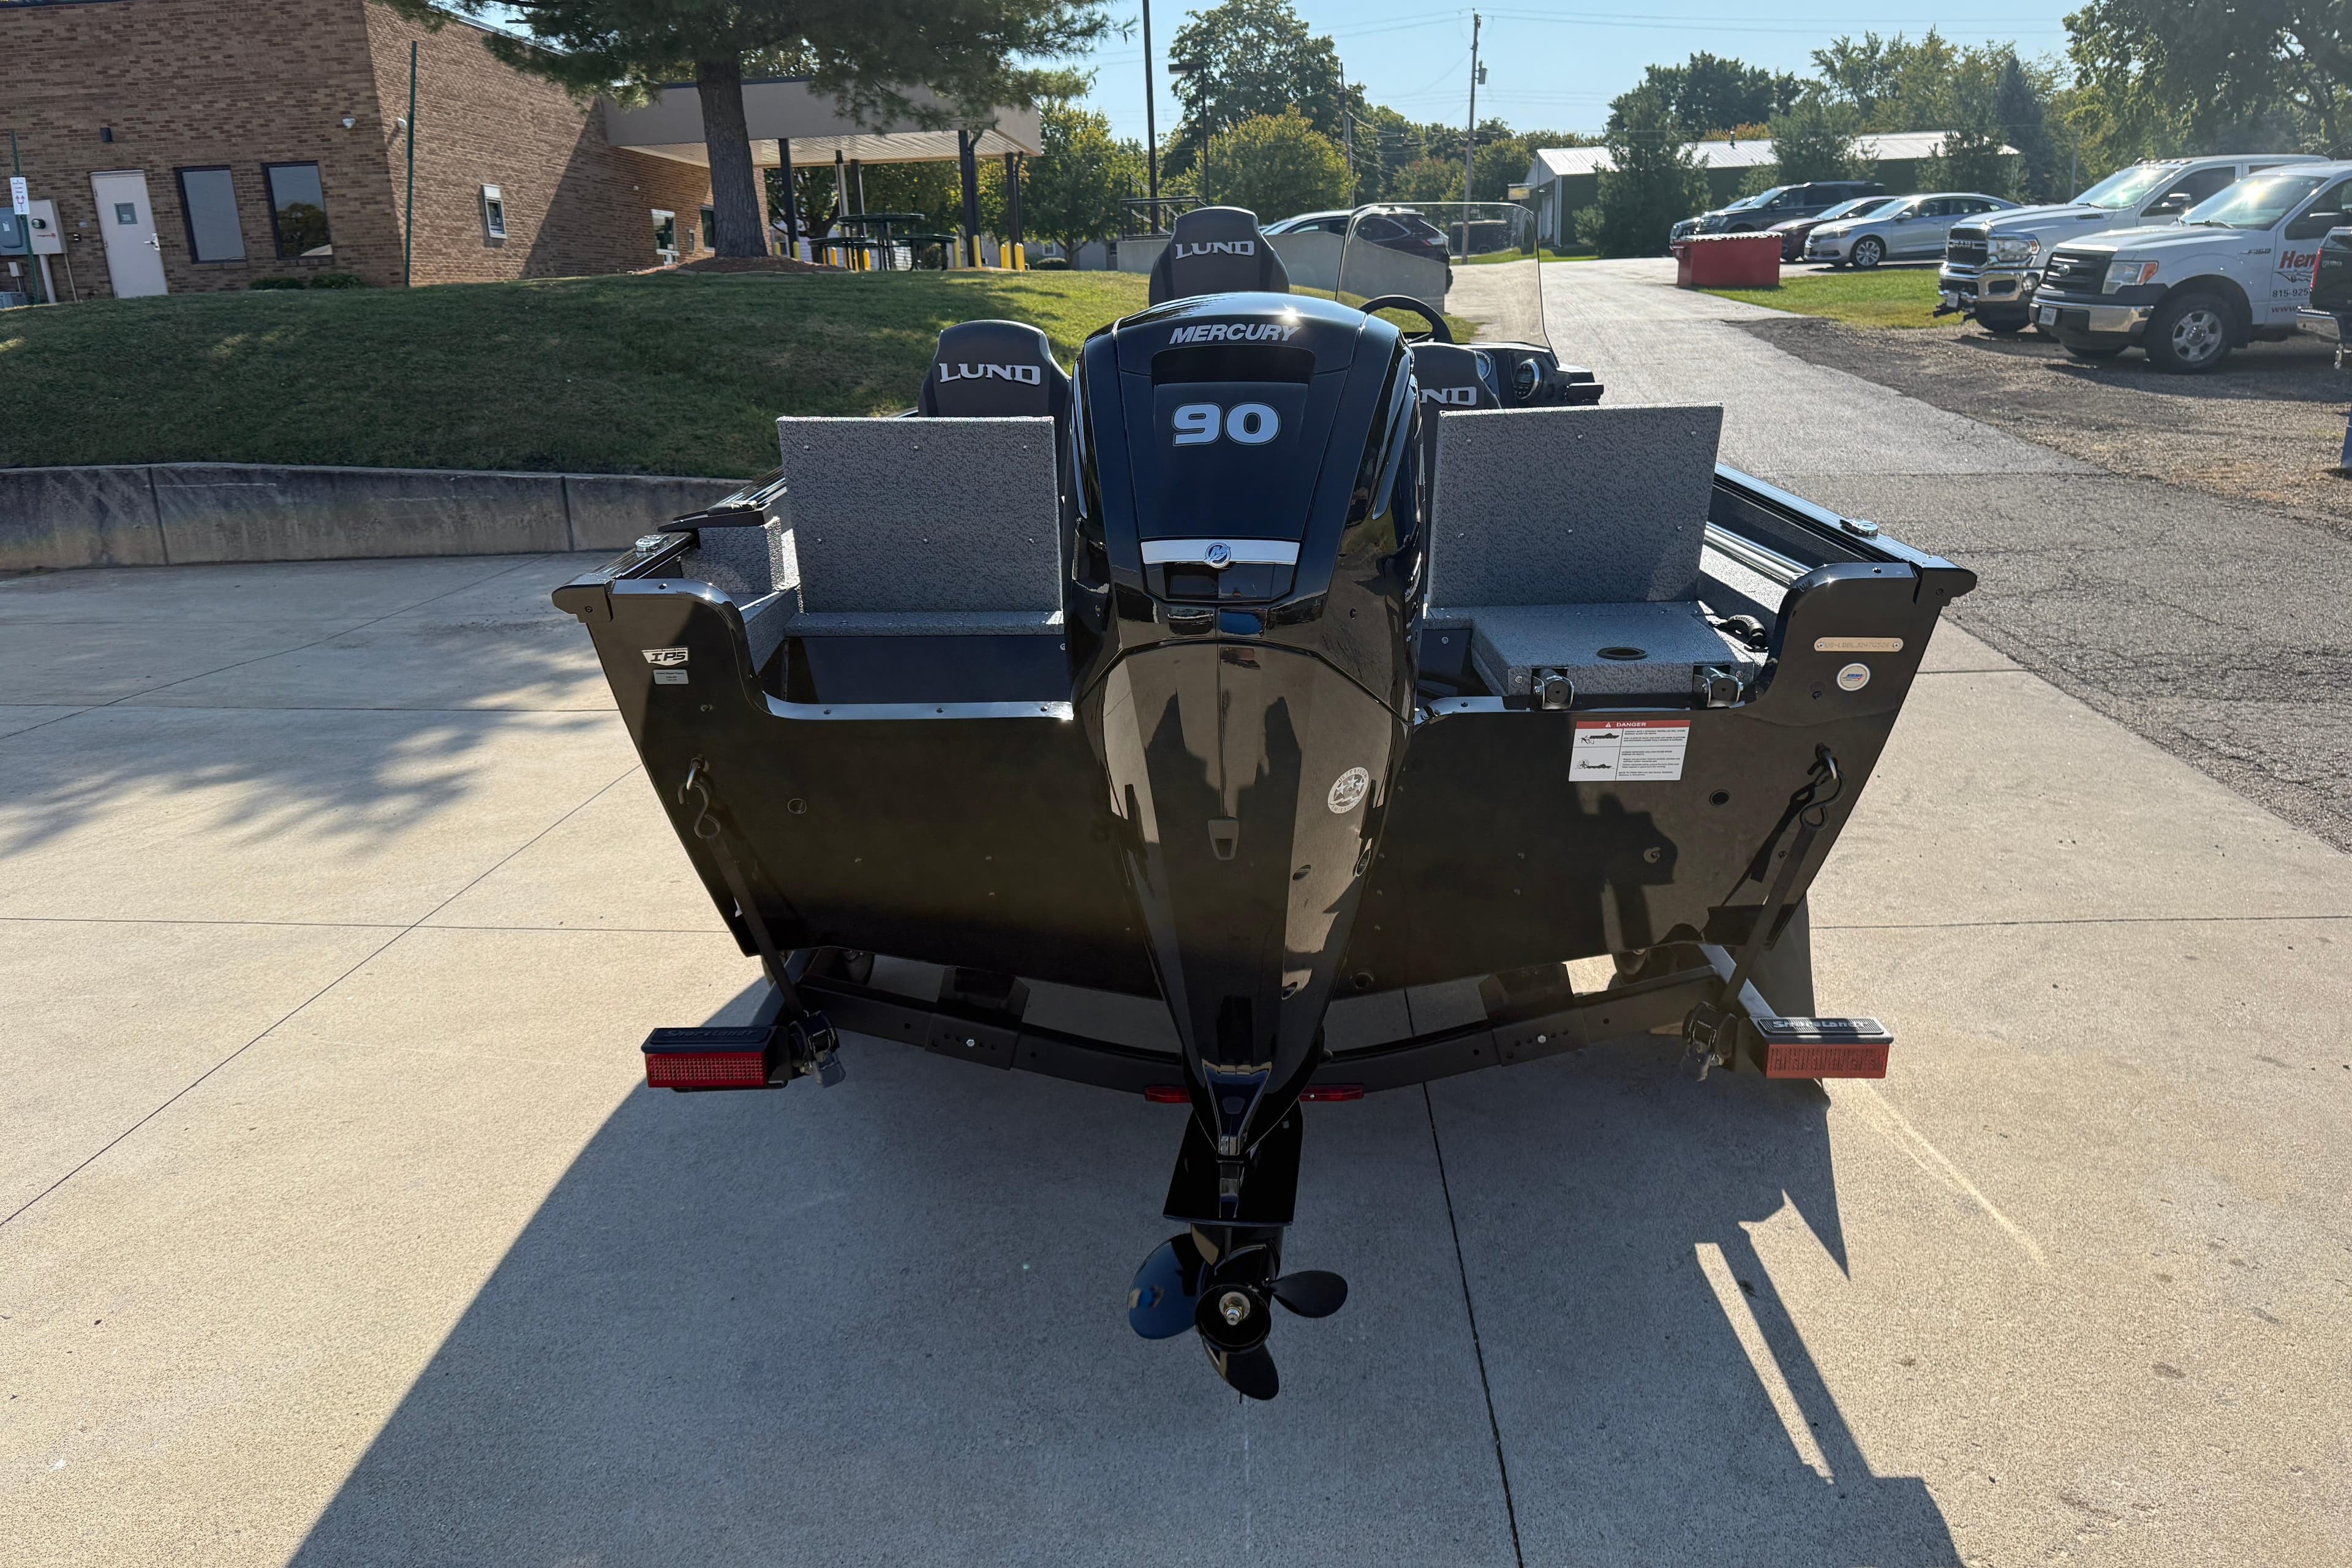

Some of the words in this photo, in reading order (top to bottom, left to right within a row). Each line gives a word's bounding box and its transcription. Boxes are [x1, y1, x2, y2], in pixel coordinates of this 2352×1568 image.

[1175, 241, 1254, 259] LUND
[2272, 288, 2309, 298] 815-925
[1169, 323, 1302, 344] MERCURY
[939, 363, 1041, 385] LUND
[1172, 401, 1281, 446] 90
[650, 651, 687, 662] IPS
